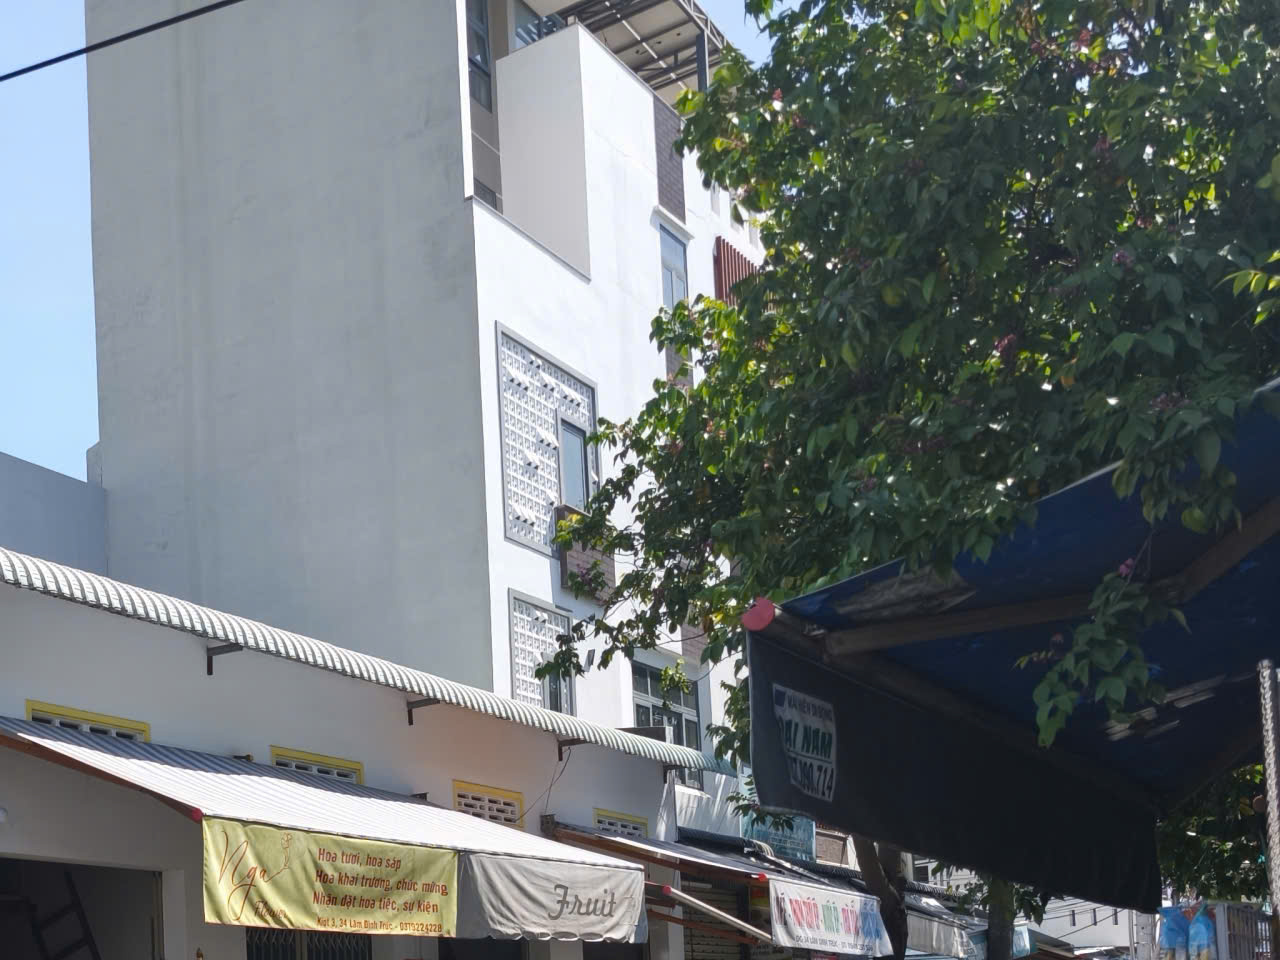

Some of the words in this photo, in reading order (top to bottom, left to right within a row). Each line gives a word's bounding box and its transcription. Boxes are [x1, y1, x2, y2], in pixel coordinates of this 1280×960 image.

[801, 724, 833, 759] NAM
[317, 847, 337, 863] Hoa
[366, 854, 382, 867] hoa
[384, 857, 401, 872] sáp
[218, 831, 270, 921] Nga
[315, 870, 335, 885] Hoa
[337, 871, 360, 887] khai
[396, 878, 418, 892] chúc
[421, 880, 449, 896] mừng
[312, 890, 337, 909] Nhận
[340, 894, 357, 910] đặt
[359, 895, 376, 909] hoa
[402, 901, 415, 914] sự
[417, 899, 439, 915] kiện
[548, 884, 617, 921] Fruit
